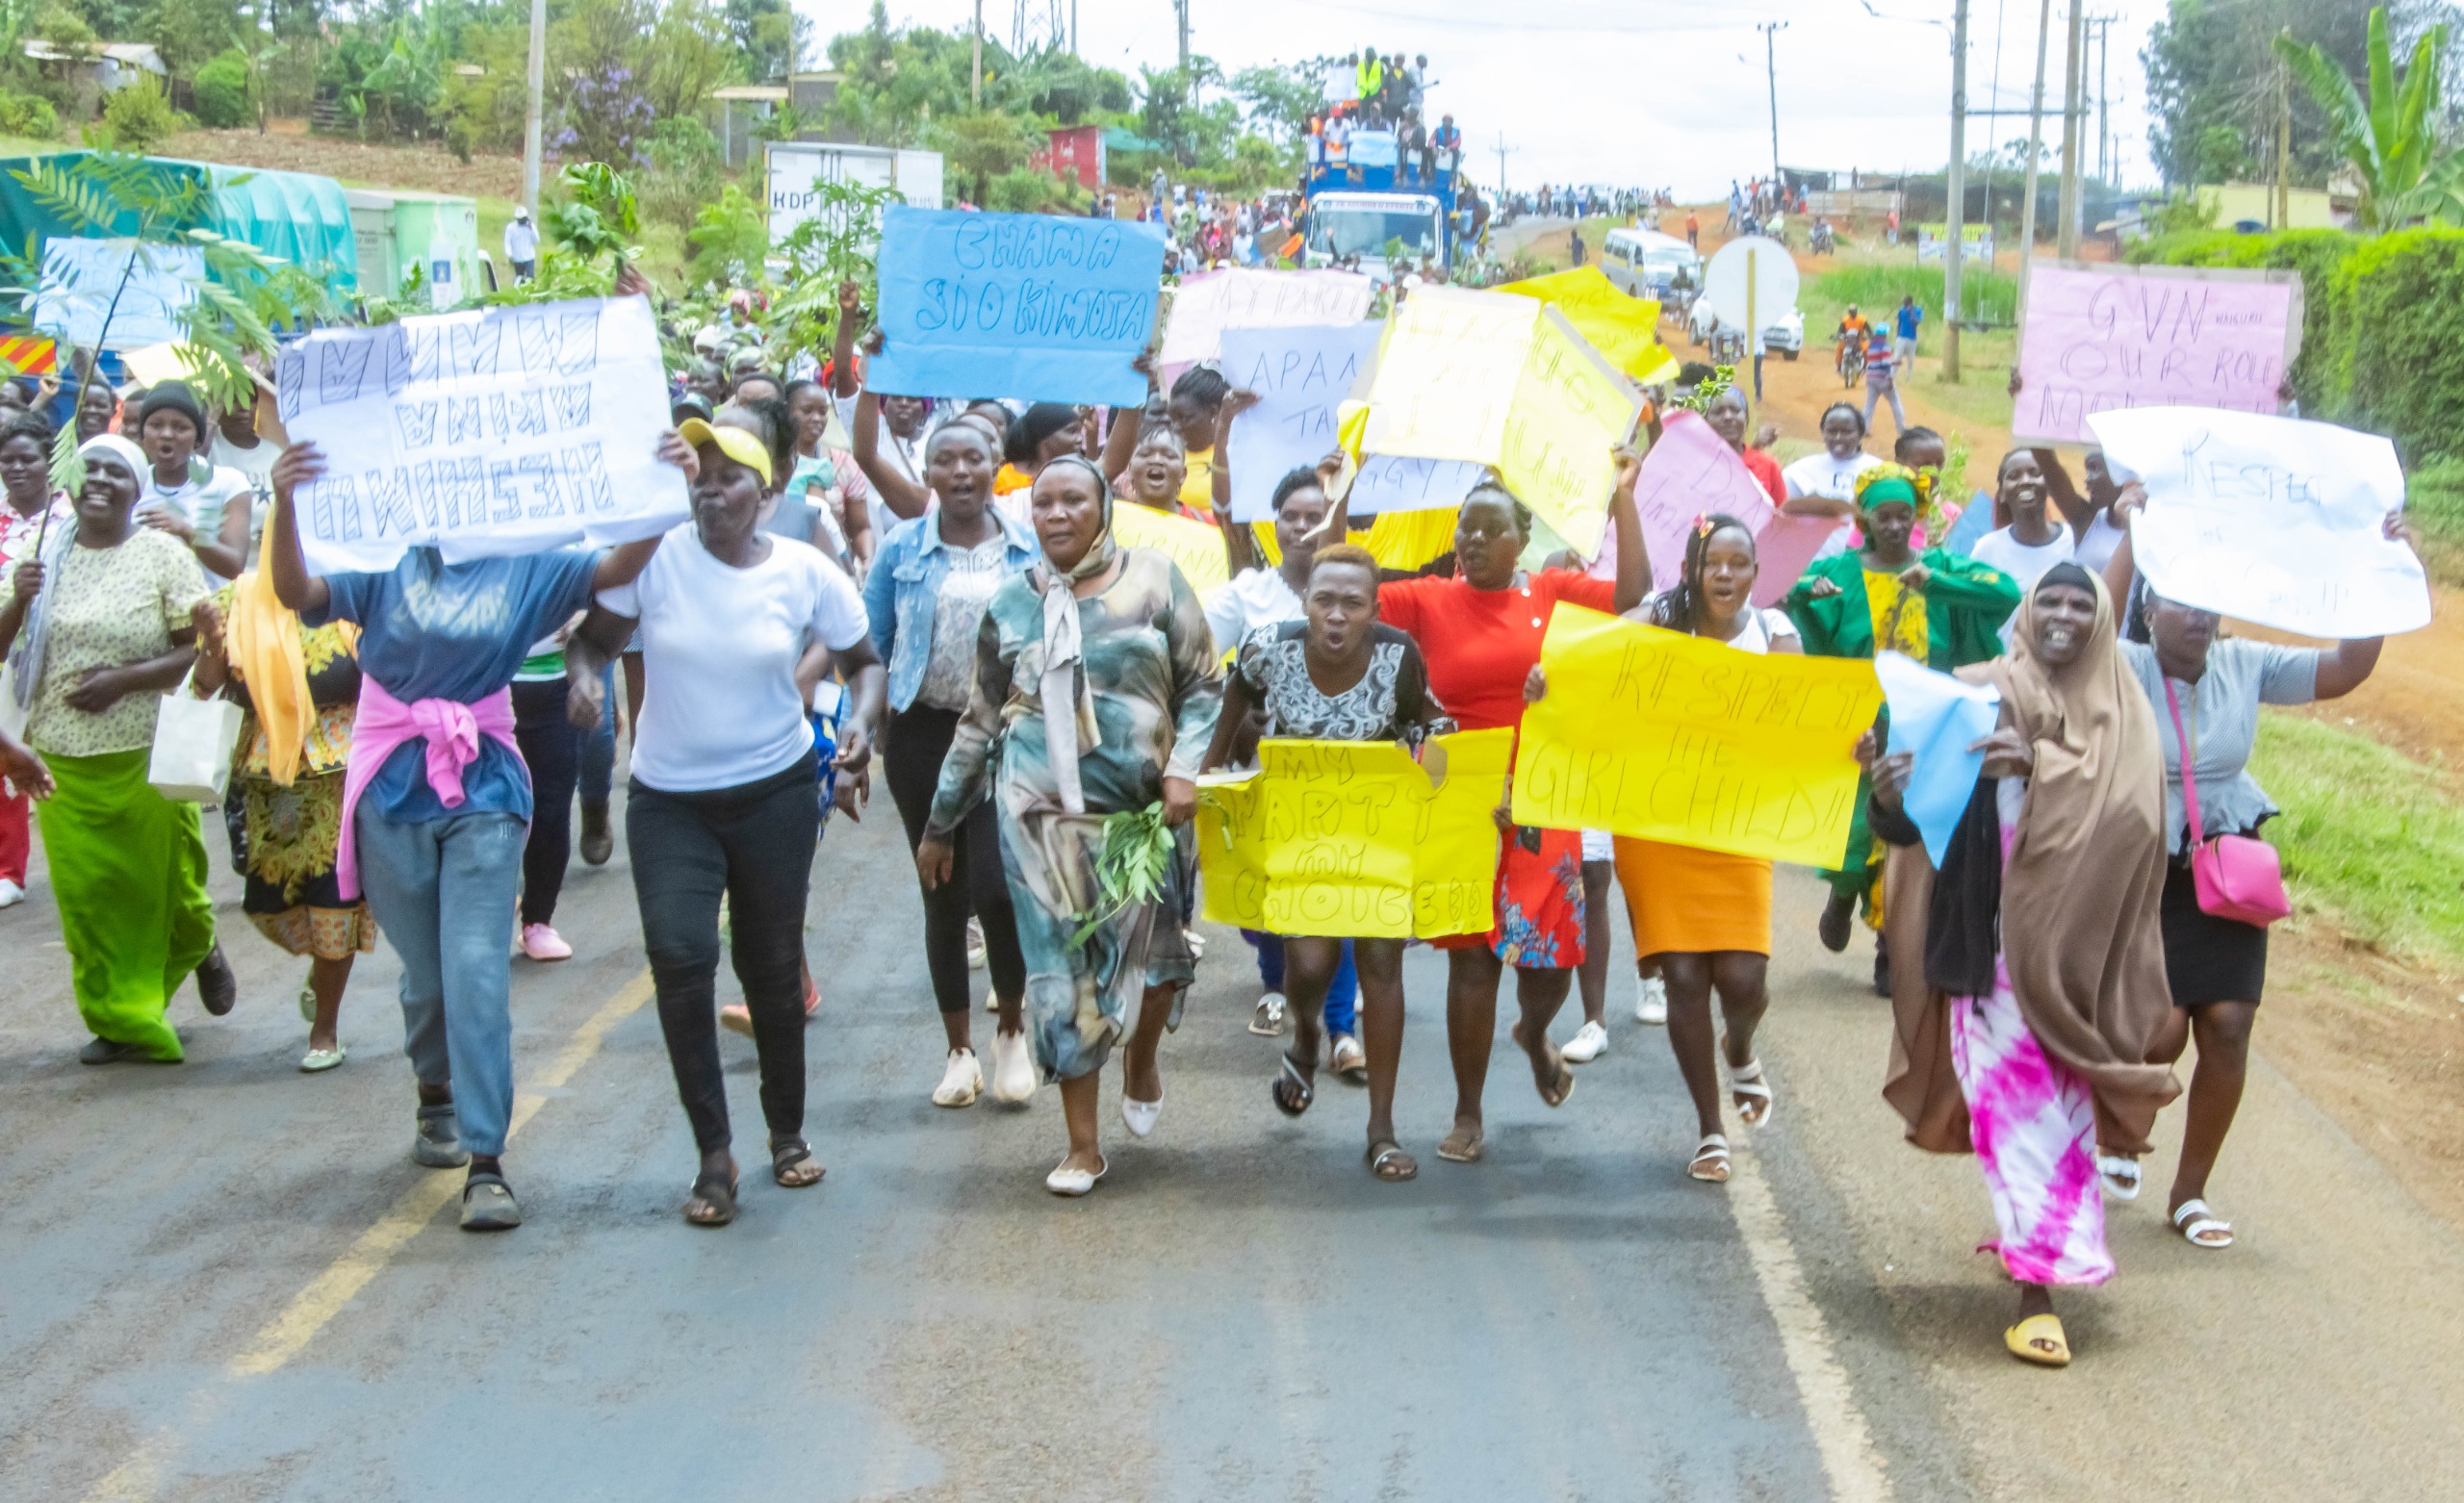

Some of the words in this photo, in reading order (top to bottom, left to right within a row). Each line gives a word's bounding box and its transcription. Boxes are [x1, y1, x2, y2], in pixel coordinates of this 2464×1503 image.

[773, 191, 814, 210] KDP
[954, 217, 1120, 270] CHAMA
[2088, 281, 2209, 344] GVN
[2060, 341, 2194, 387] OUR
[396, 381, 593, 451] AKINA
[312, 441, 615, 542] HESHIMU
[1610, 639, 1874, 731] RESPECT
[1262, 743, 1355, 785] MY
[1527, 738, 1644, 821] GIRL
